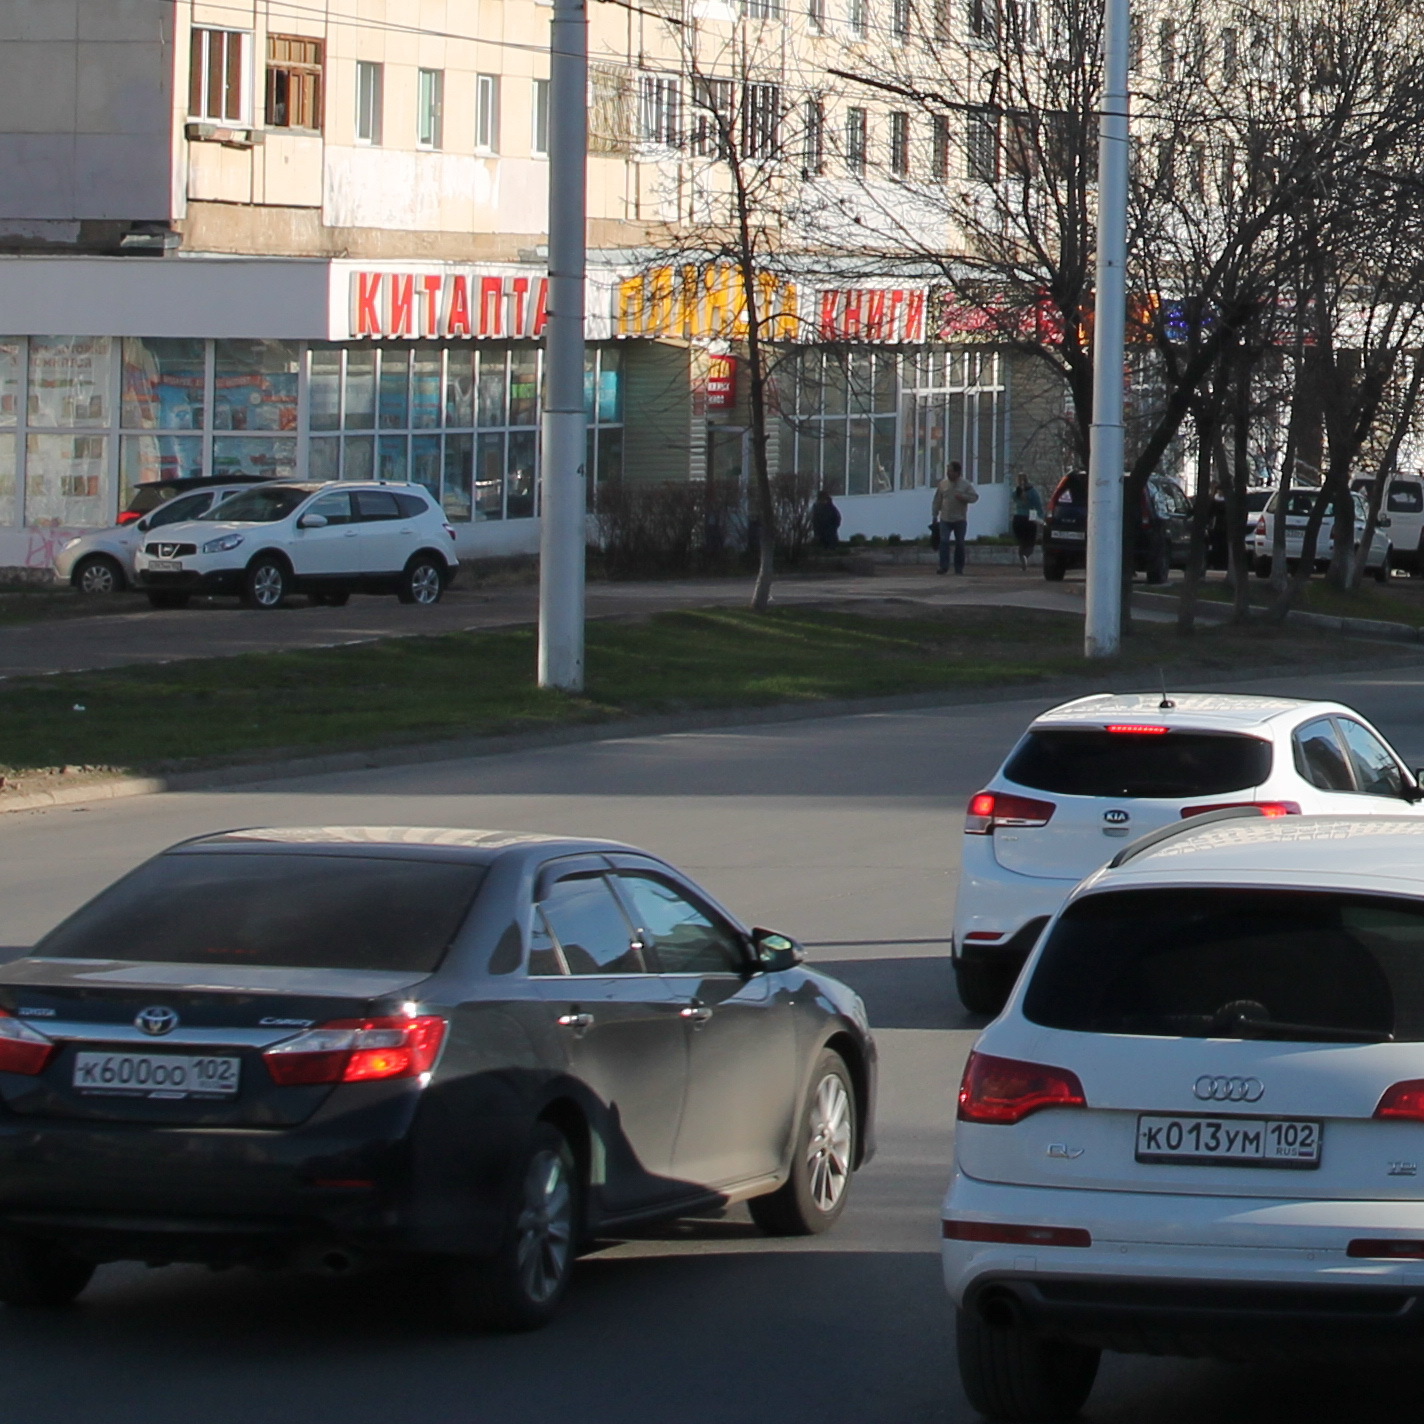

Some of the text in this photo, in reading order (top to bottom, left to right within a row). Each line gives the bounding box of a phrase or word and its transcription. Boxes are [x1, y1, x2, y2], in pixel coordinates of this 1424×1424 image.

[350, 272, 548, 338] КИТАПТА
[818, 288, 925, 340] КНИГИ
[1106, 812, 1127, 821] KIA
[194, 1058, 232, 1081] 102
[1147, 1122, 1315, 1154] К013УМ 102
[1276, 1147, 1299, 1156] RUS
